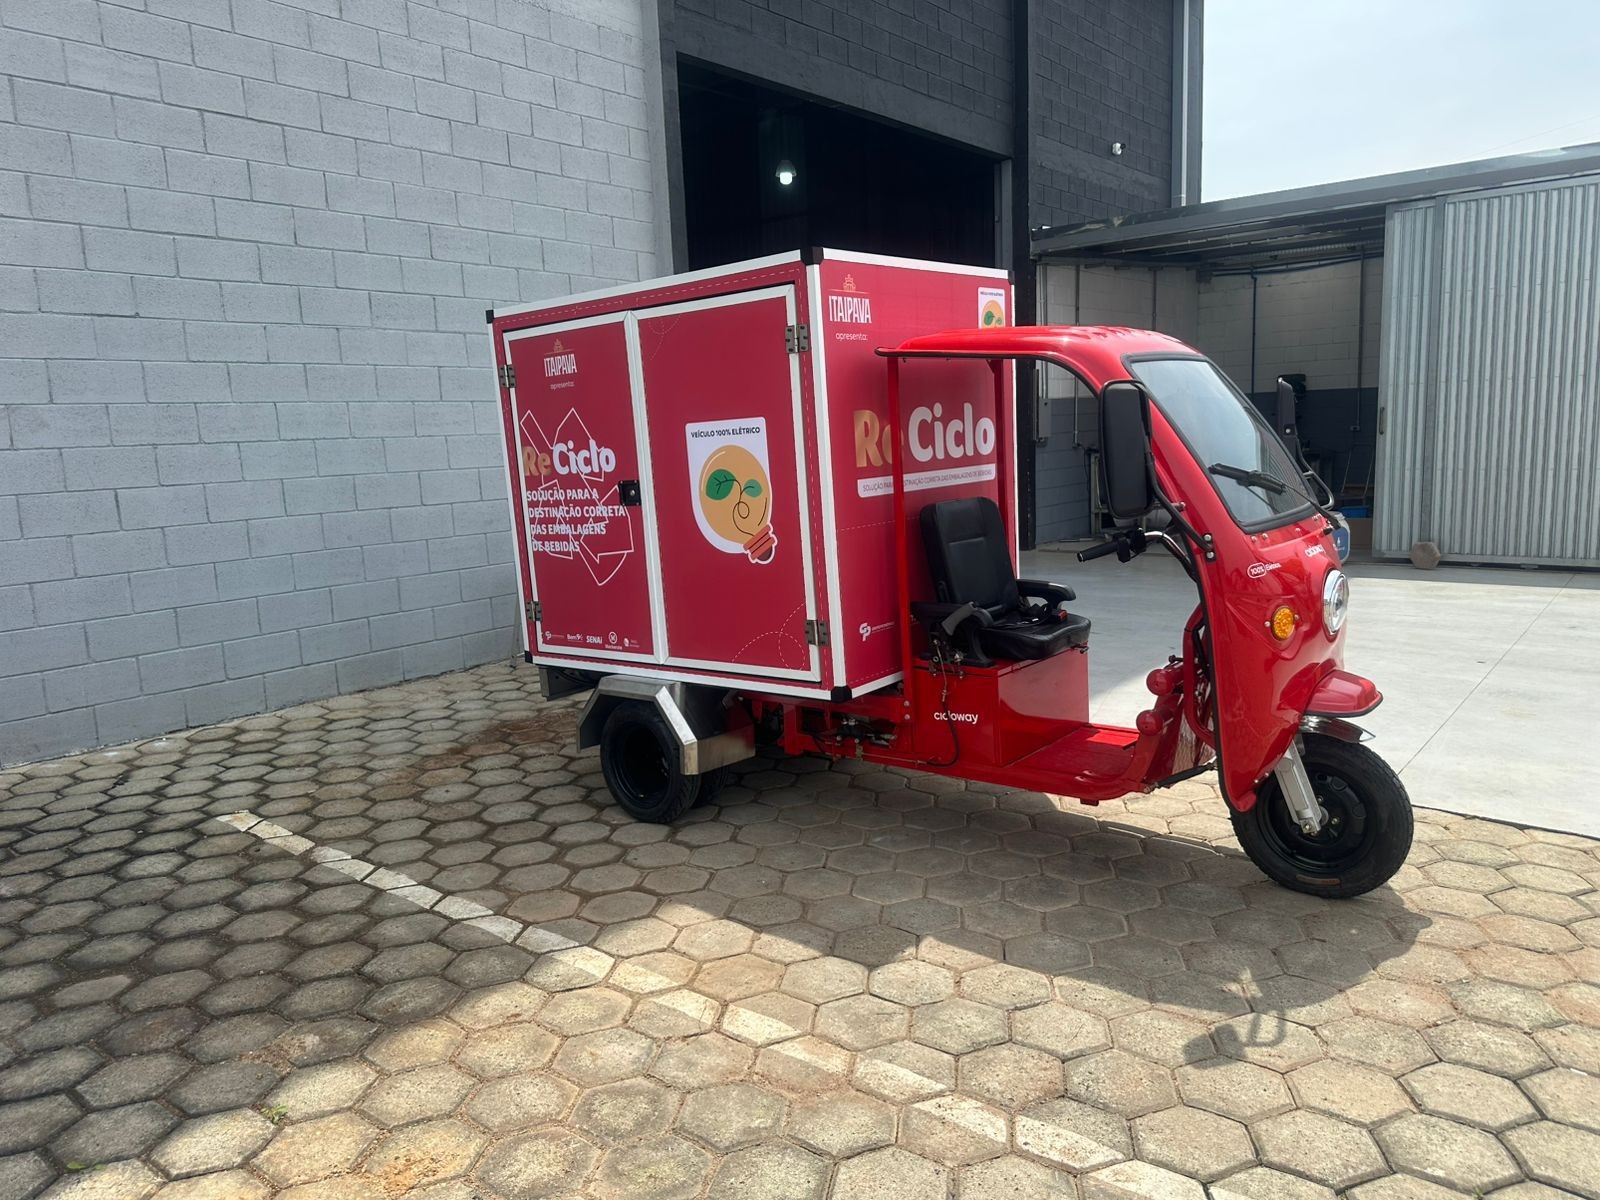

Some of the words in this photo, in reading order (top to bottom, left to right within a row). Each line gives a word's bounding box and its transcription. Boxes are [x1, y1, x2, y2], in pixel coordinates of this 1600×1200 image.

[828, 295, 872, 324] ITAIPAVA
[543, 353, 578, 377] ITAIPAVA
[690, 429, 715, 439] VEÍCULO
[715, 428, 732, 437] 100%
[731, 426, 761, 436] ELÉTRICO
[526, 487, 565, 504] SOLUÇÃO
[566, 488, 591, 500] PARA
[591, 488, 599, 499] A
[529, 504, 582, 521] DESTINAÇÃO
[583, 505, 626, 517] CORRETA
[531, 524, 547, 535] DAS
[548, 523, 607, 535] EMBALAGENS
[533, 541, 543, 551] DE
[543, 540, 580, 552] BEBIDAS
